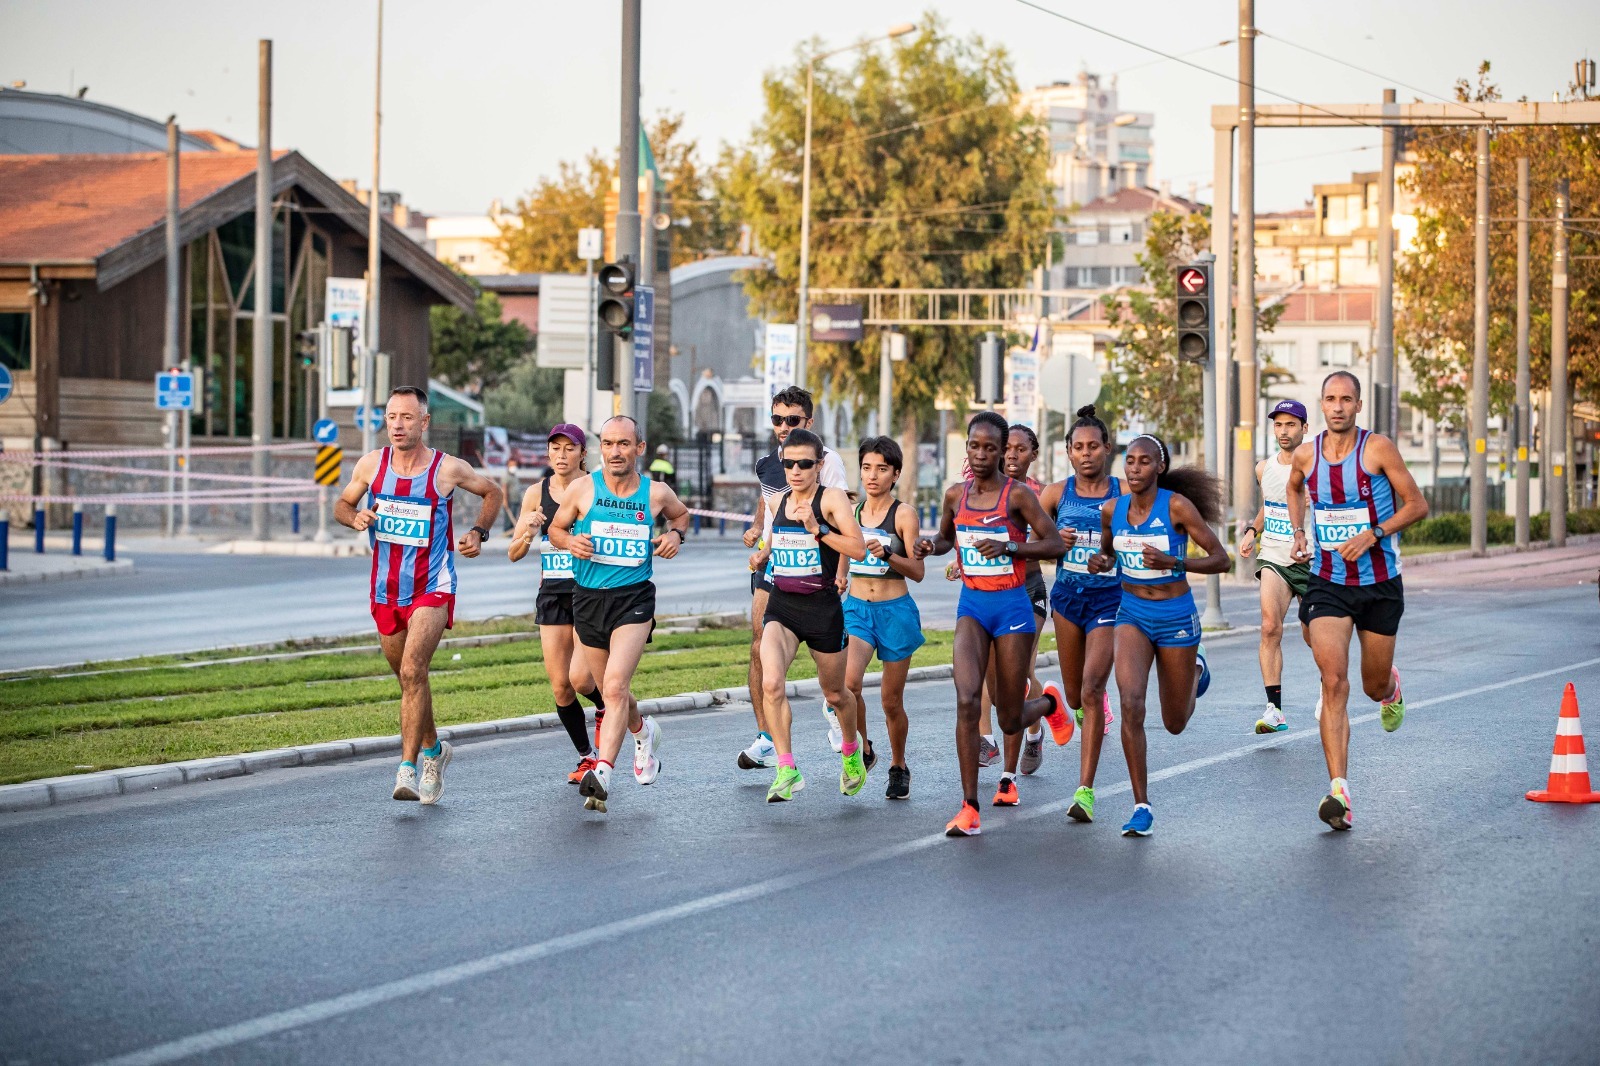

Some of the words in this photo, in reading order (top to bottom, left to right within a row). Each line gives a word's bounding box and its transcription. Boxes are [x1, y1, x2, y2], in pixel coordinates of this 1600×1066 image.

[595, 496, 646, 512] AĞAOĞLU
[377, 515, 425, 537] 10271
[594, 537, 647, 557] 10153
[773, 549, 819, 566] 10182
